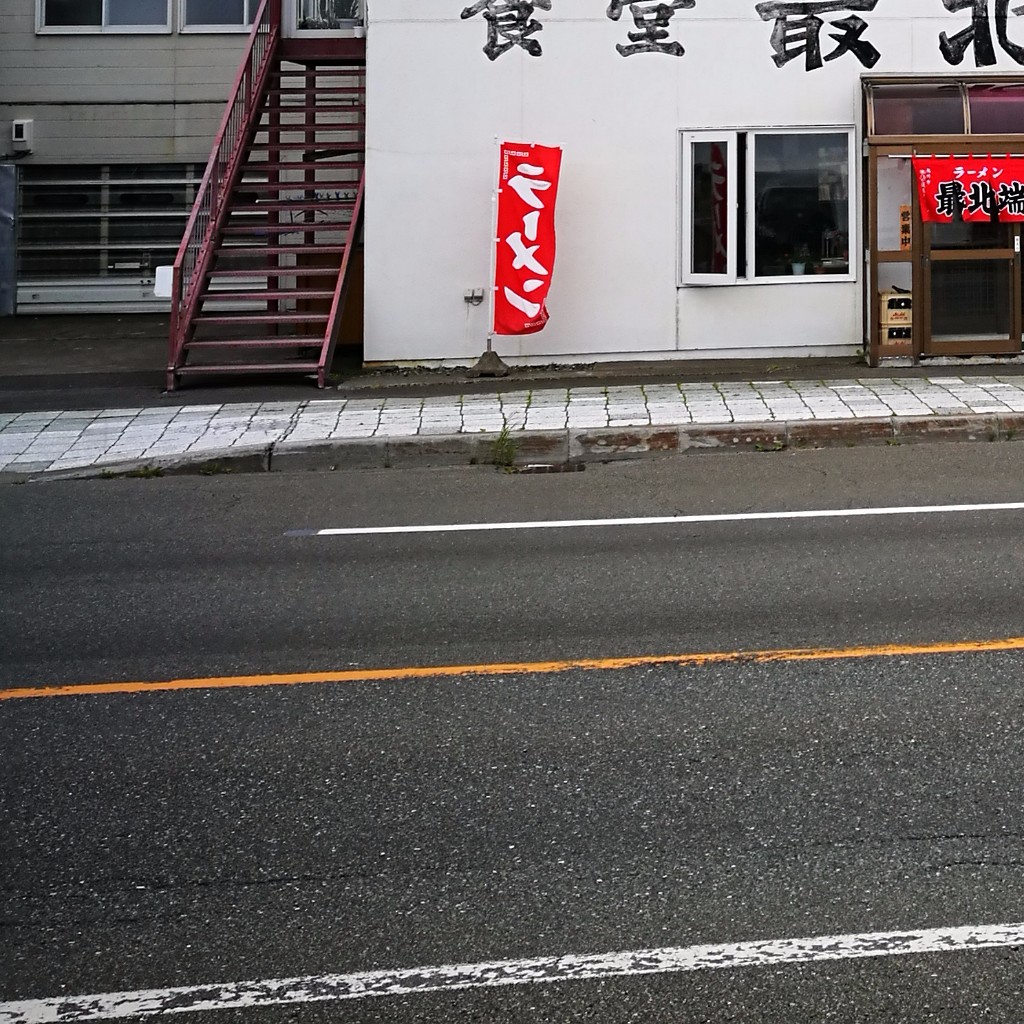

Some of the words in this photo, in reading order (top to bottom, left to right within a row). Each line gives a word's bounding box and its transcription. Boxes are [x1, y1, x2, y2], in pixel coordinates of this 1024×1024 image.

[953, 166, 1004, 179] ラーメン
[508, 163, 552, 318] ラーメン
